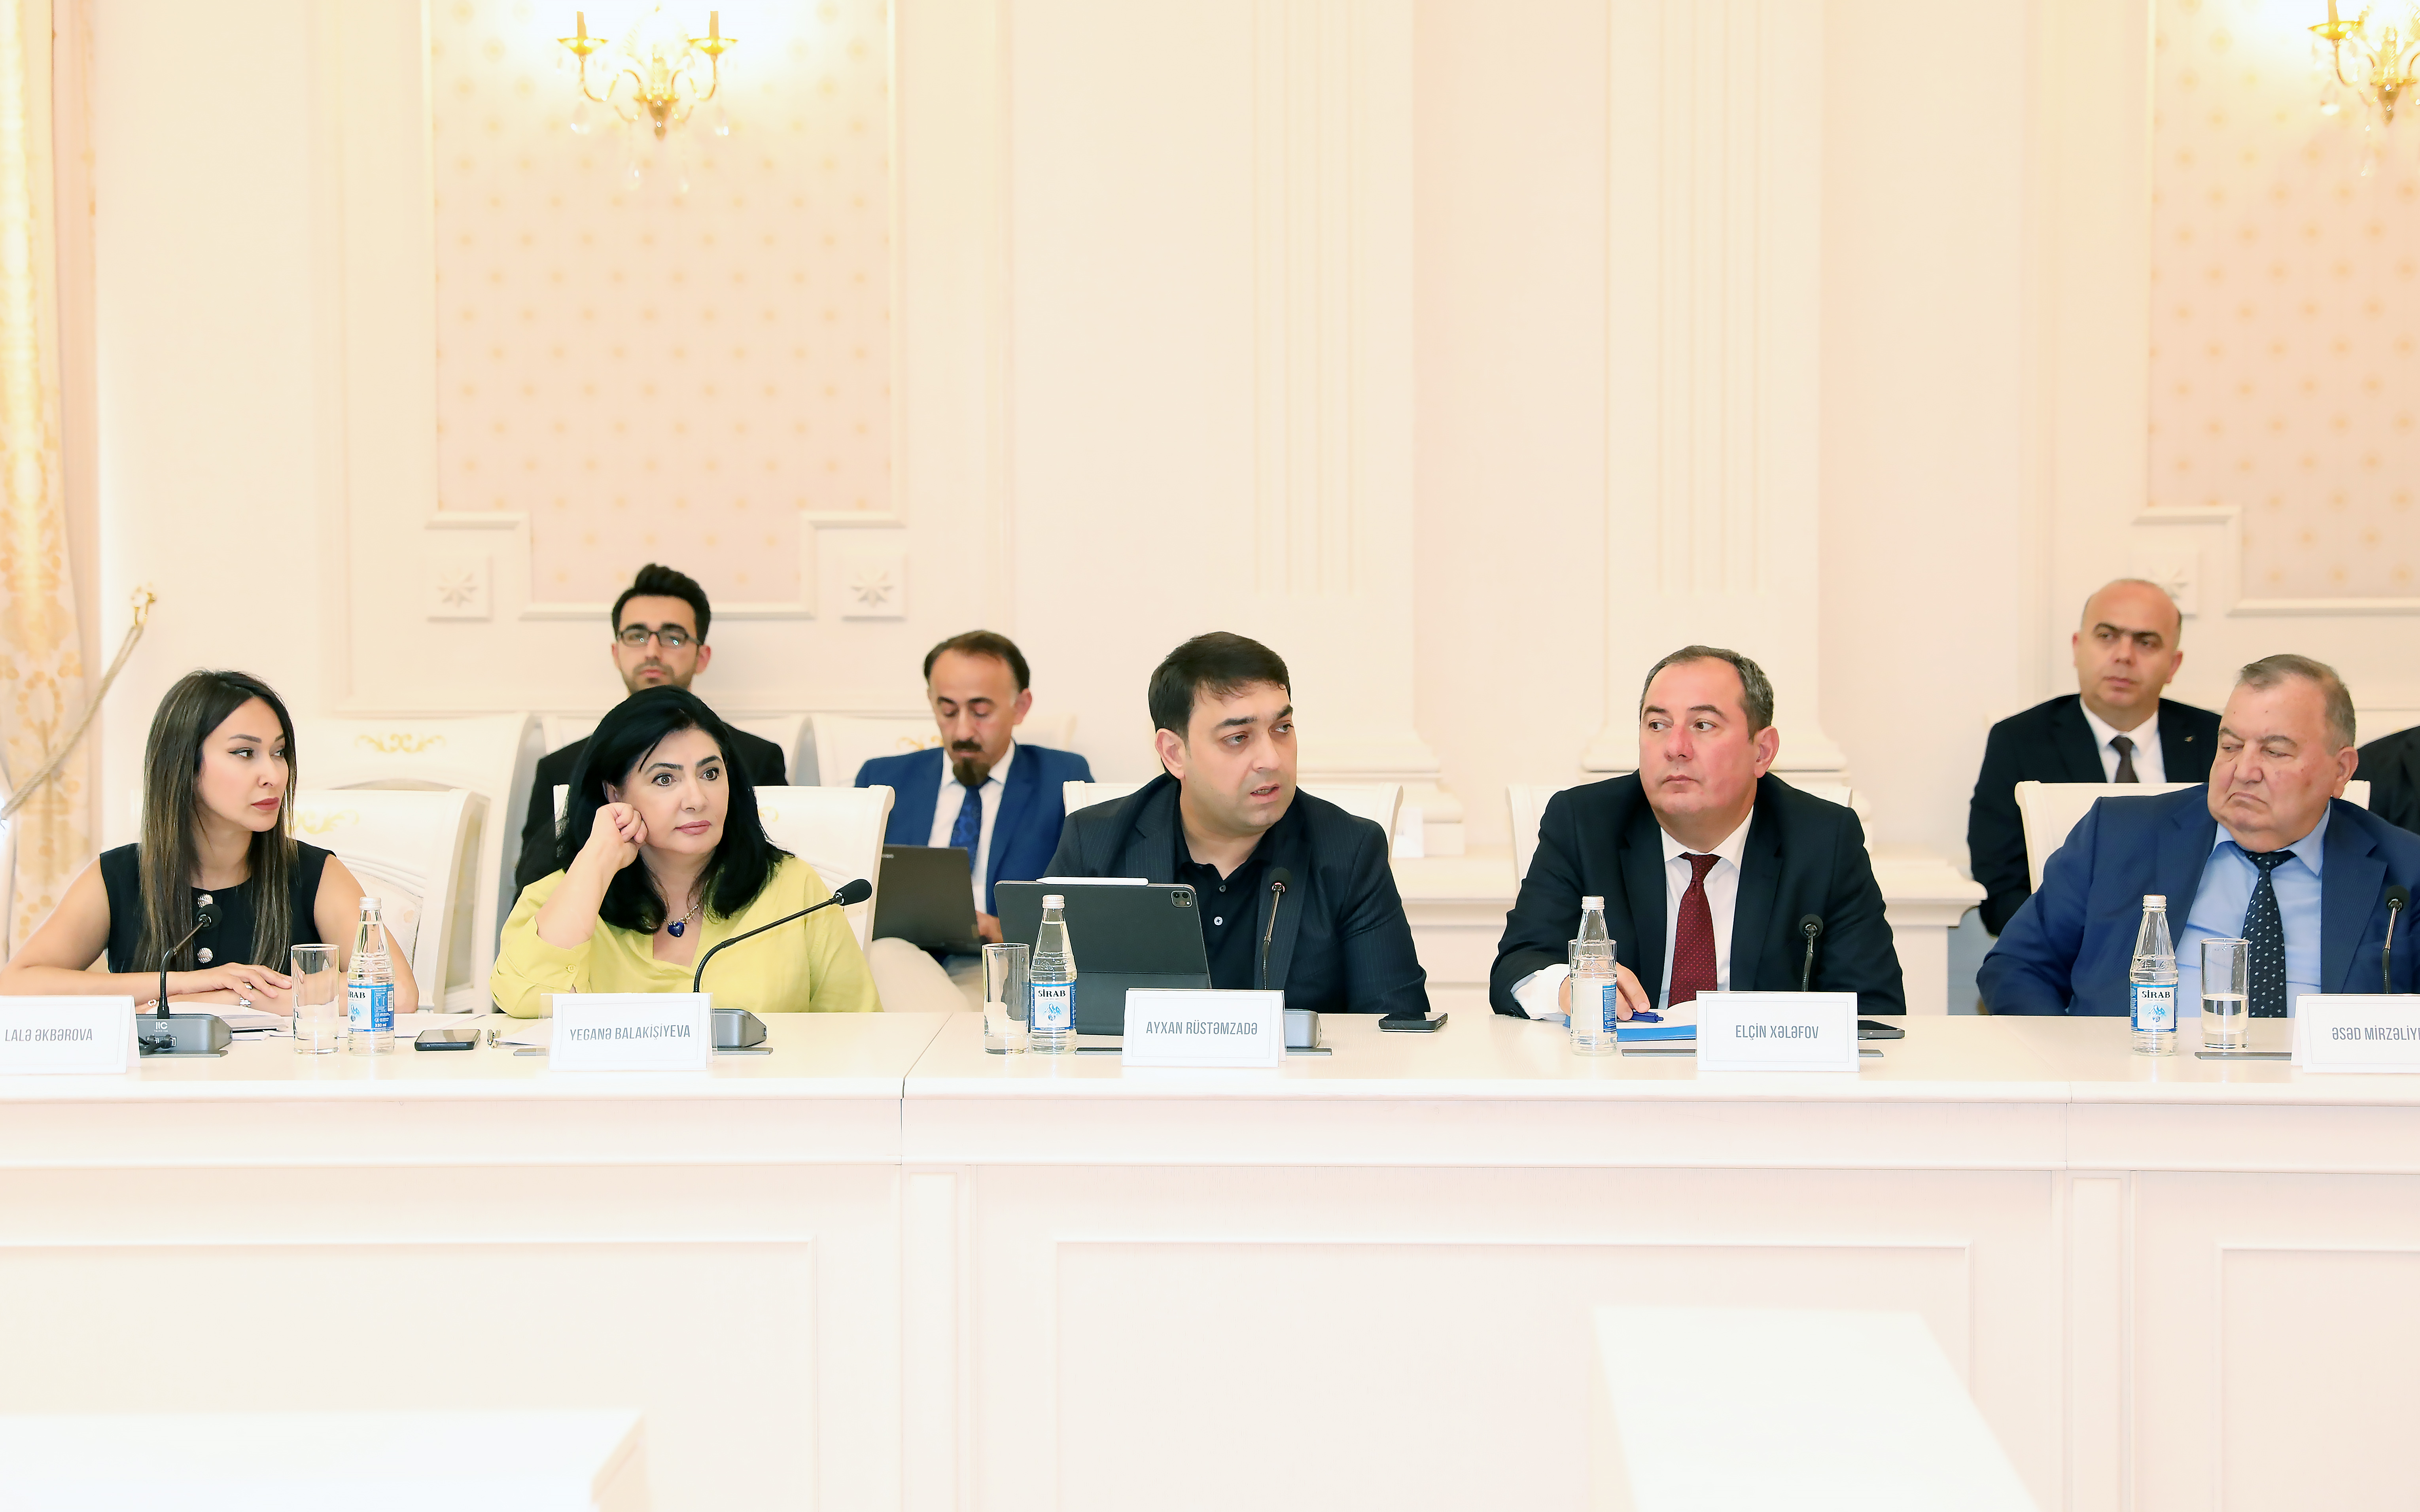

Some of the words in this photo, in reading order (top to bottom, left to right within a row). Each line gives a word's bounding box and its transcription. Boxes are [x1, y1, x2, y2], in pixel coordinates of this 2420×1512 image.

[348, 989, 365, 998] İRAB
[1038, 989, 1066, 997] SİRAB
[2142, 990, 2170, 998] SİRAB
[570, 1028, 611, 1041] YEGANƏ
[615, 1023, 690, 1040] BALAKİŞİYEVA
[1146, 1021, 1183, 1034] AYXAN
[1186, 1020, 1258, 1035] RÜSTƏMZADƏ
[1736, 1023, 1766, 1040] ELÇİN
[1770, 1025, 1819, 1039] XƏLƏFOV
[2332, 1027, 2361, 1040] ƏSƏD
[5, 1029, 32, 1041] LALƏ
[35, 1028, 93, 1041] ƏKBƏROVA
